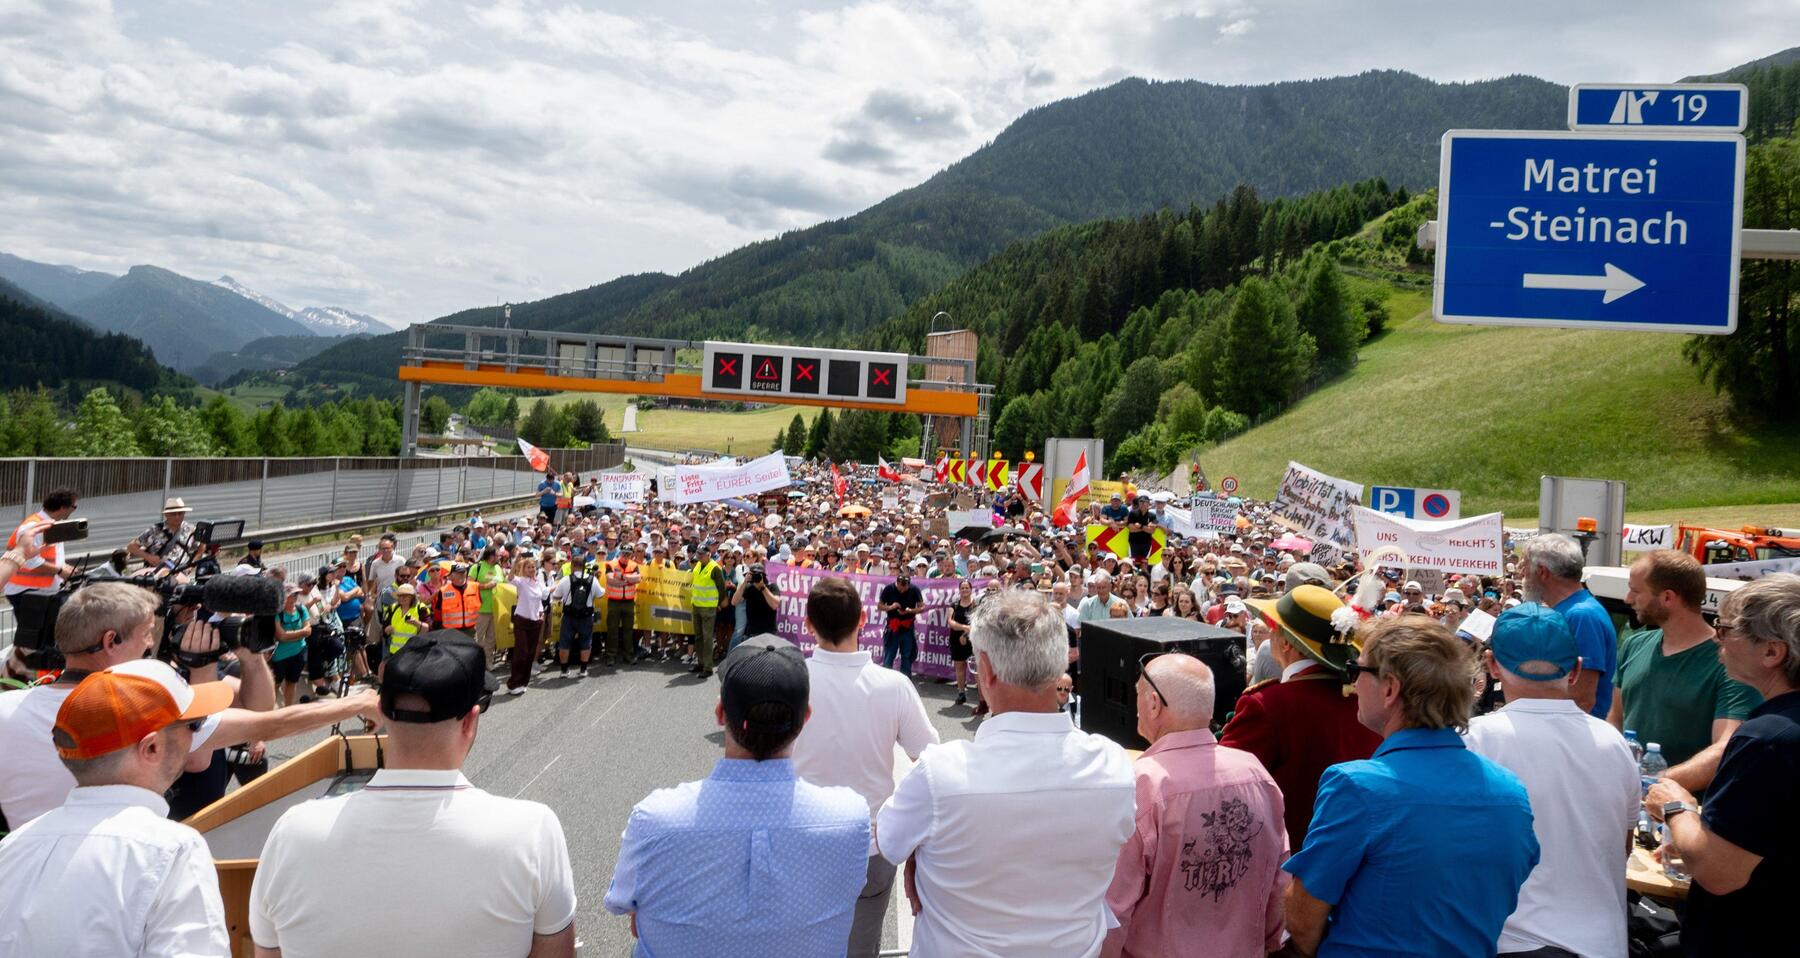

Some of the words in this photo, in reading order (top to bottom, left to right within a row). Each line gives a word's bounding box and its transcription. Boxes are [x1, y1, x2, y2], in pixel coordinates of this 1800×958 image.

[1671, 94, 1708, 122] 19
[1523, 158, 1658, 194] Matrei
[1490, 206, 1688, 245] -Steinach
[752, 381, 780, 391] SPERRE
[680, 474, 700, 482] Liste
[612, 482, 632, 490] STATT
[716, 478, 752, 490] EURER
[1224, 481, 1235, 489] 60
[611, 491, 638, 500] TRANSIT
[684, 487, 702, 496] Tirol
[1194, 499, 1239, 509] DEUTSCHLAND
[1379, 489, 1400, 513] P
[1211, 518, 1232, 526] TIROL
[1194, 523, 1236, 533] ERSTICKT!
[1376, 532, 1398, 543] UNS
[1628, 528, 1665, 545] LKW
[1433, 558, 1446, 566] IM
[1449, 559, 1498, 570] VERKEHR
[928, 630, 950, 646] Eise
